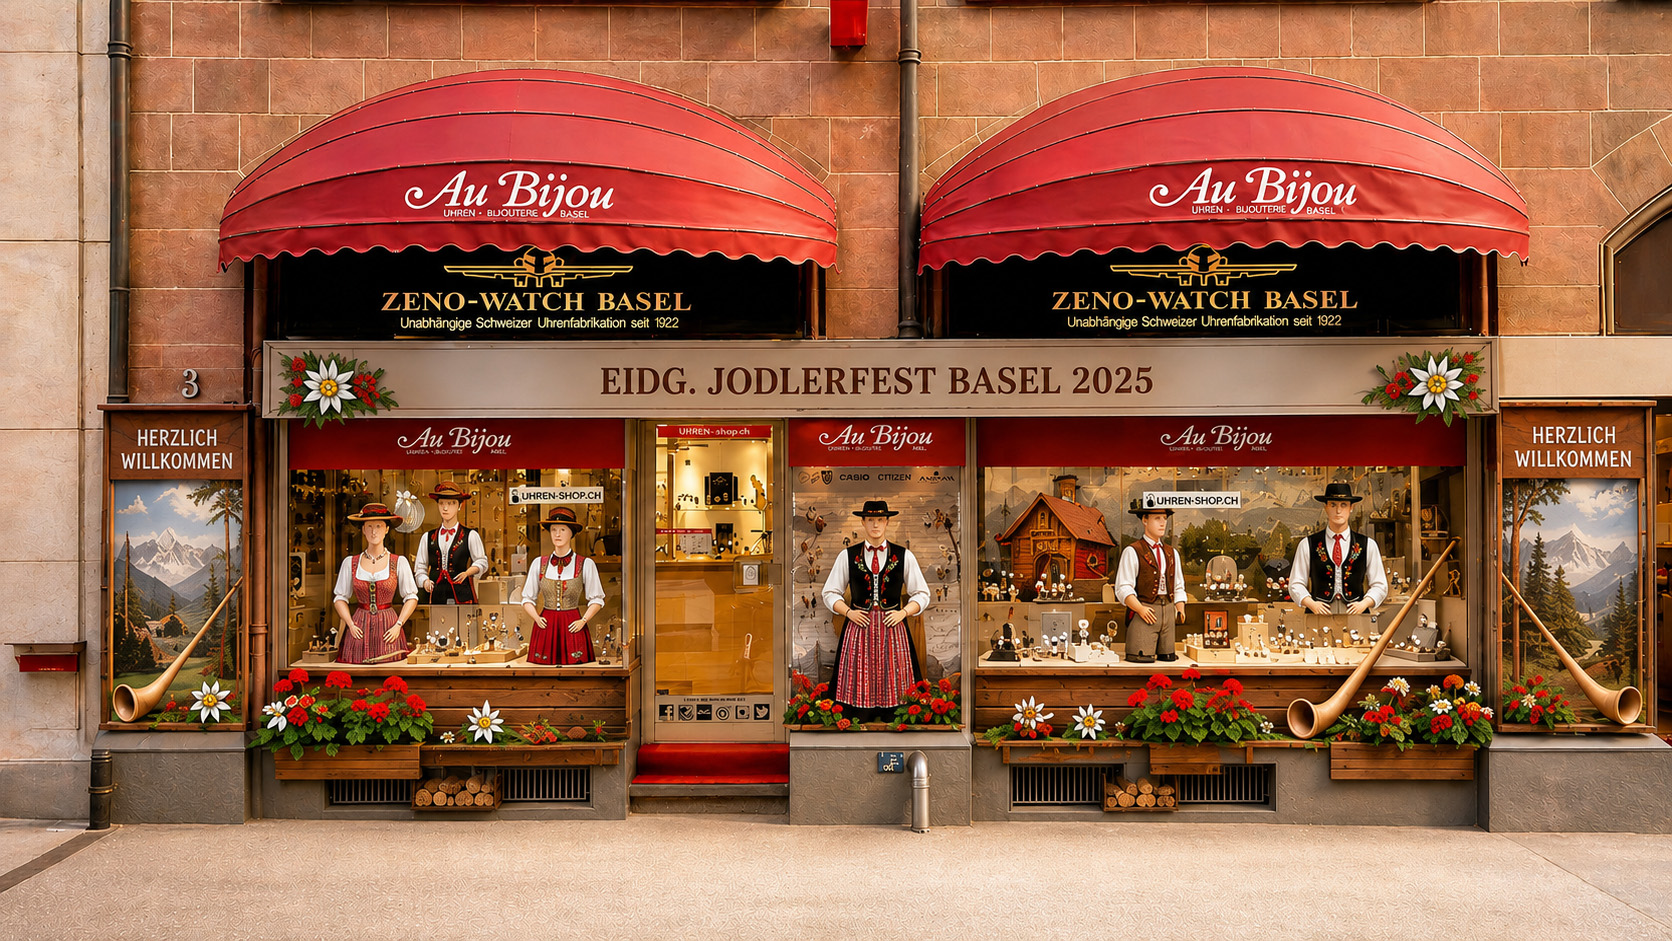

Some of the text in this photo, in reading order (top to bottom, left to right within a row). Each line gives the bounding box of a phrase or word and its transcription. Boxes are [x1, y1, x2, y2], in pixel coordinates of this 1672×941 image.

[404, 170, 614, 217] Au Bijou
[1149, 166, 1357, 215] Au Bijou
[443, 208, 476, 218] UHREN
[560, 209, 590, 218] BASEL
[1191, 204, 1336, 215] UHREN BIJOUTERIE BASEL
[380, 291, 692, 312] ZENO-WATCH BASEL
[1051, 290, 1359, 310] ZENO-WATCH BASEL
[400, 316, 679, 331] Unabhängige Schweizer Uhrenfabrikation seit 1922
[1067, 315, 1342, 331] Unabhängige Schweizer Uhrenfabrikation seit 1922
[181, 368, 200, 399] 3
[600, 366, 1153, 395] EIDG. JODLERFEST BASEL 2025
[137, 428, 218, 447] HERZLICH
[397, 426, 512, 455] Au Bijou
[818, 424, 934, 451] Au Bijou
[1160, 424, 1273, 452] Au Bijou
[1532, 426, 1616, 444] HERZLICH
[120, 452, 233, 470] WILLKOMMEN
[1514, 449, 1632, 468] WILLKOMMEN
[521, 491, 602, 501] UHREN-SHOP.CH
[1156, 496, 1239, 506] UHREN-SHOP.CH
